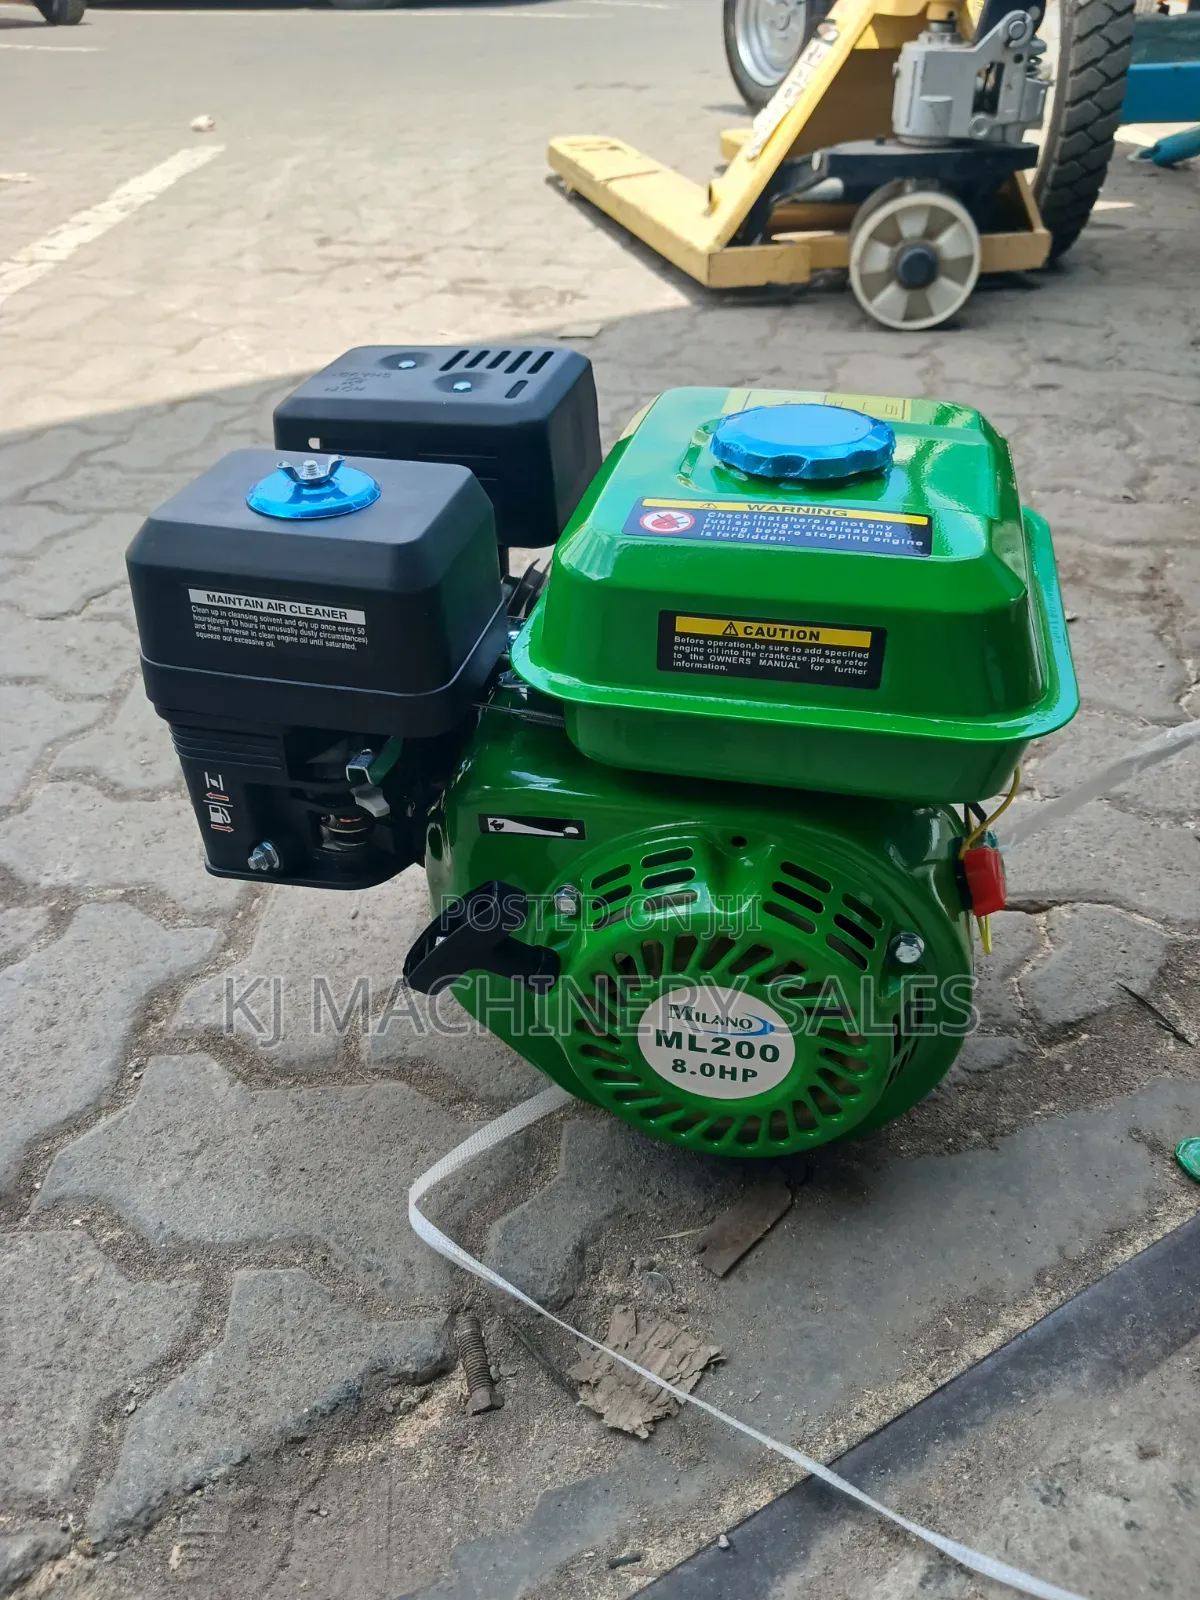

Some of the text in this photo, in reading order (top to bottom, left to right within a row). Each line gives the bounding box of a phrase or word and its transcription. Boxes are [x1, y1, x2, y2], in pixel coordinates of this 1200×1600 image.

[707, 512, 749, 520] Check
[753, 514, 781, 522] that
[784, 516, 820, 524] there
[841, 520, 864, 528] not
[867, 523, 893, 531] any
[746, 504, 848, 517] WARNING
[703, 524, 924, 546] Filling before stopping engine
[735, 520, 789, 530] spilling
[716, 531, 791, 542] forbidden.
[206, 594, 348, 620] MAINTAIN AIR CLEANER
[191, 605, 209, 614] Clean
[220, 609, 227, 617] in
[227, 611, 258, 622] cleansing
[259, 616, 283, 625] solvent
[284, 618, 296, 626] and
[297, 620, 308, 629] dry
[320, 623, 336, 631] once
[337, 625, 356, 635] every
[357, 627, 365, 635] 50
[231, 619, 239, 627] 10
[239, 620, 258, 629] hours
[267, 625, 298, 636] unusually
[299, 628, 318, 638] dusty
[195, 631, 221, 640] squeeze
[233, 636, 265, 647] excessive
[207, 623, 221, 632] then
[222, 626, 249, 636] immerse
[250, 629, 257, 637] in
[258, 631, 276, 640] clean
[276, 634, 299, 643] engine
[299, 636, 308, 644] oil
[309, 638, 324, 646] until
[743, 625, 820, 641] CAUTION
[673, 644, 704, 653] engine
[721, 648, 740, 656] into
[742, 649, 757, 658] the
[844, 659, 868, 667] refer
[674, 635, 705, 645] Before
[804, 647, 822, 655] add
[824, 649, 870, 659] specified
[672, 660, 728, 671] information.
[690, 653, 705, 661] the
[709, 654, 752, 665] OWNERS
[758, 659, 800, 669] MANUAL
[810, 663, 825, 671] for
[834, 666, 868, 675] further
[667, 1004, 753, 1029] MILANO
[655, 1028, 780, 1063] ML200
[671, 1058, 758, 1083] 8.0HP
